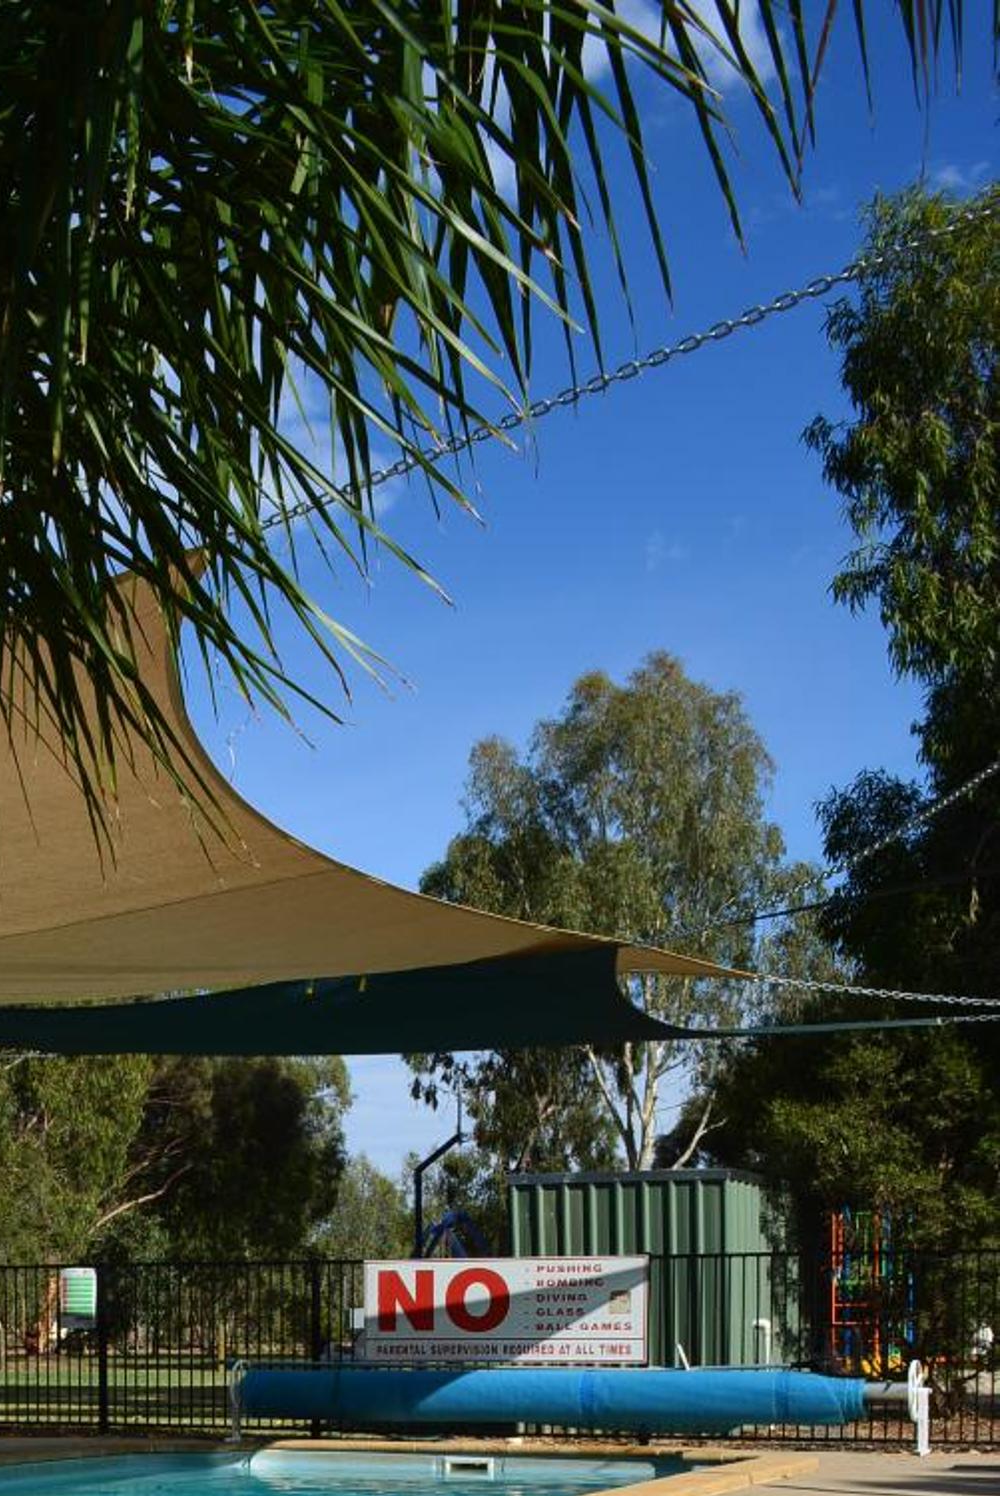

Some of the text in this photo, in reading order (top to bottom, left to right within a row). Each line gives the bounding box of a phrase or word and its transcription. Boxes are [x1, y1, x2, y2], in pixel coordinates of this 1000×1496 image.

[536, 1264, 602, 1273] PUSHING
[536, 1278, 605, 1287] BOMBING
[377, 1267, 511, 1333] NO
[536, 1293, 588, 1303] DIVING
[535, 1307, 586, 1317] GLASS
[535, 1322, 632, 1331] BALL GAMES
[377, 1343, 632, 1355] PARENTAL SUPERVISION REQUIRED AT ALL TIMES
